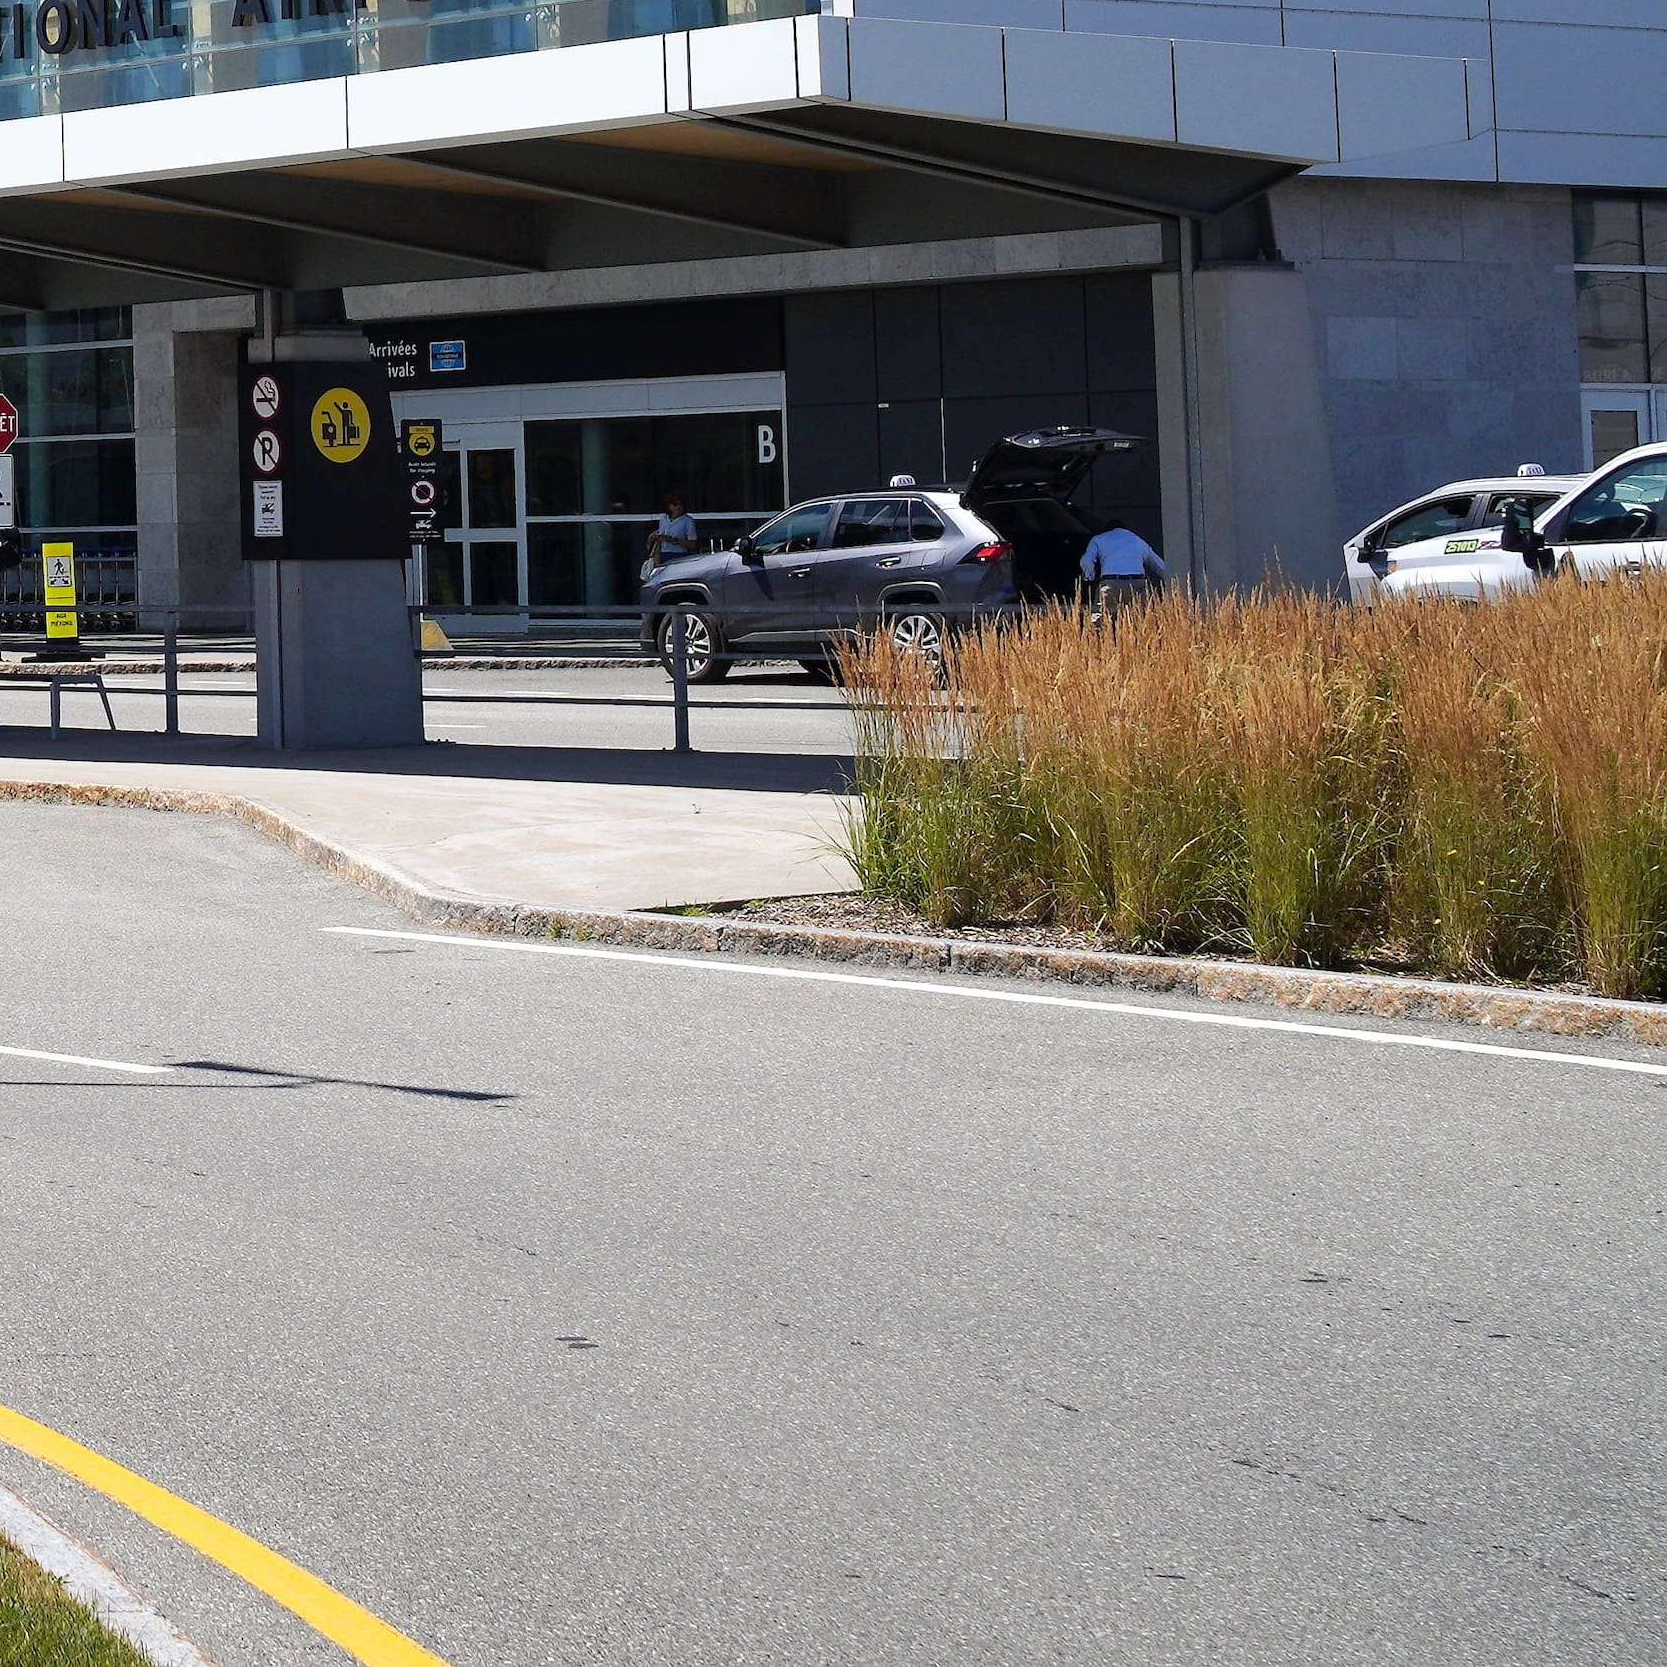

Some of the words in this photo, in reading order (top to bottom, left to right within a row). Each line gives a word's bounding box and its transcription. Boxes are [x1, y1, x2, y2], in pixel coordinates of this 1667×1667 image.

[369, 340, 418, 358] Arrivées
[387, 361, 416, 378] ivals
[758, 425, 776, 463] B
